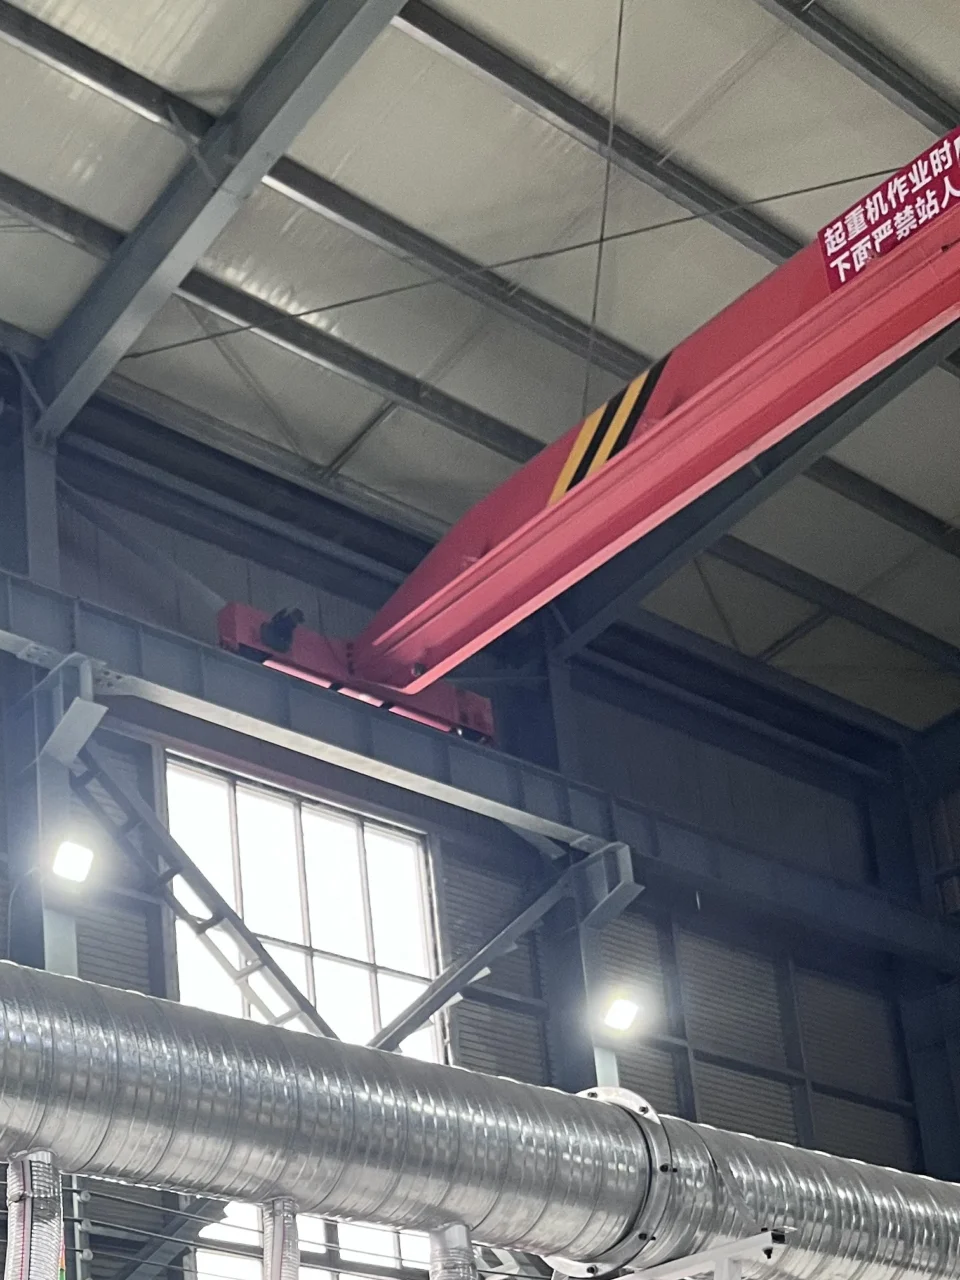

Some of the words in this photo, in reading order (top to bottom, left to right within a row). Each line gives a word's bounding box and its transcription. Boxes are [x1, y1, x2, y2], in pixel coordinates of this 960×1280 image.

[824, 134, 960, 257] 起重机作业时
